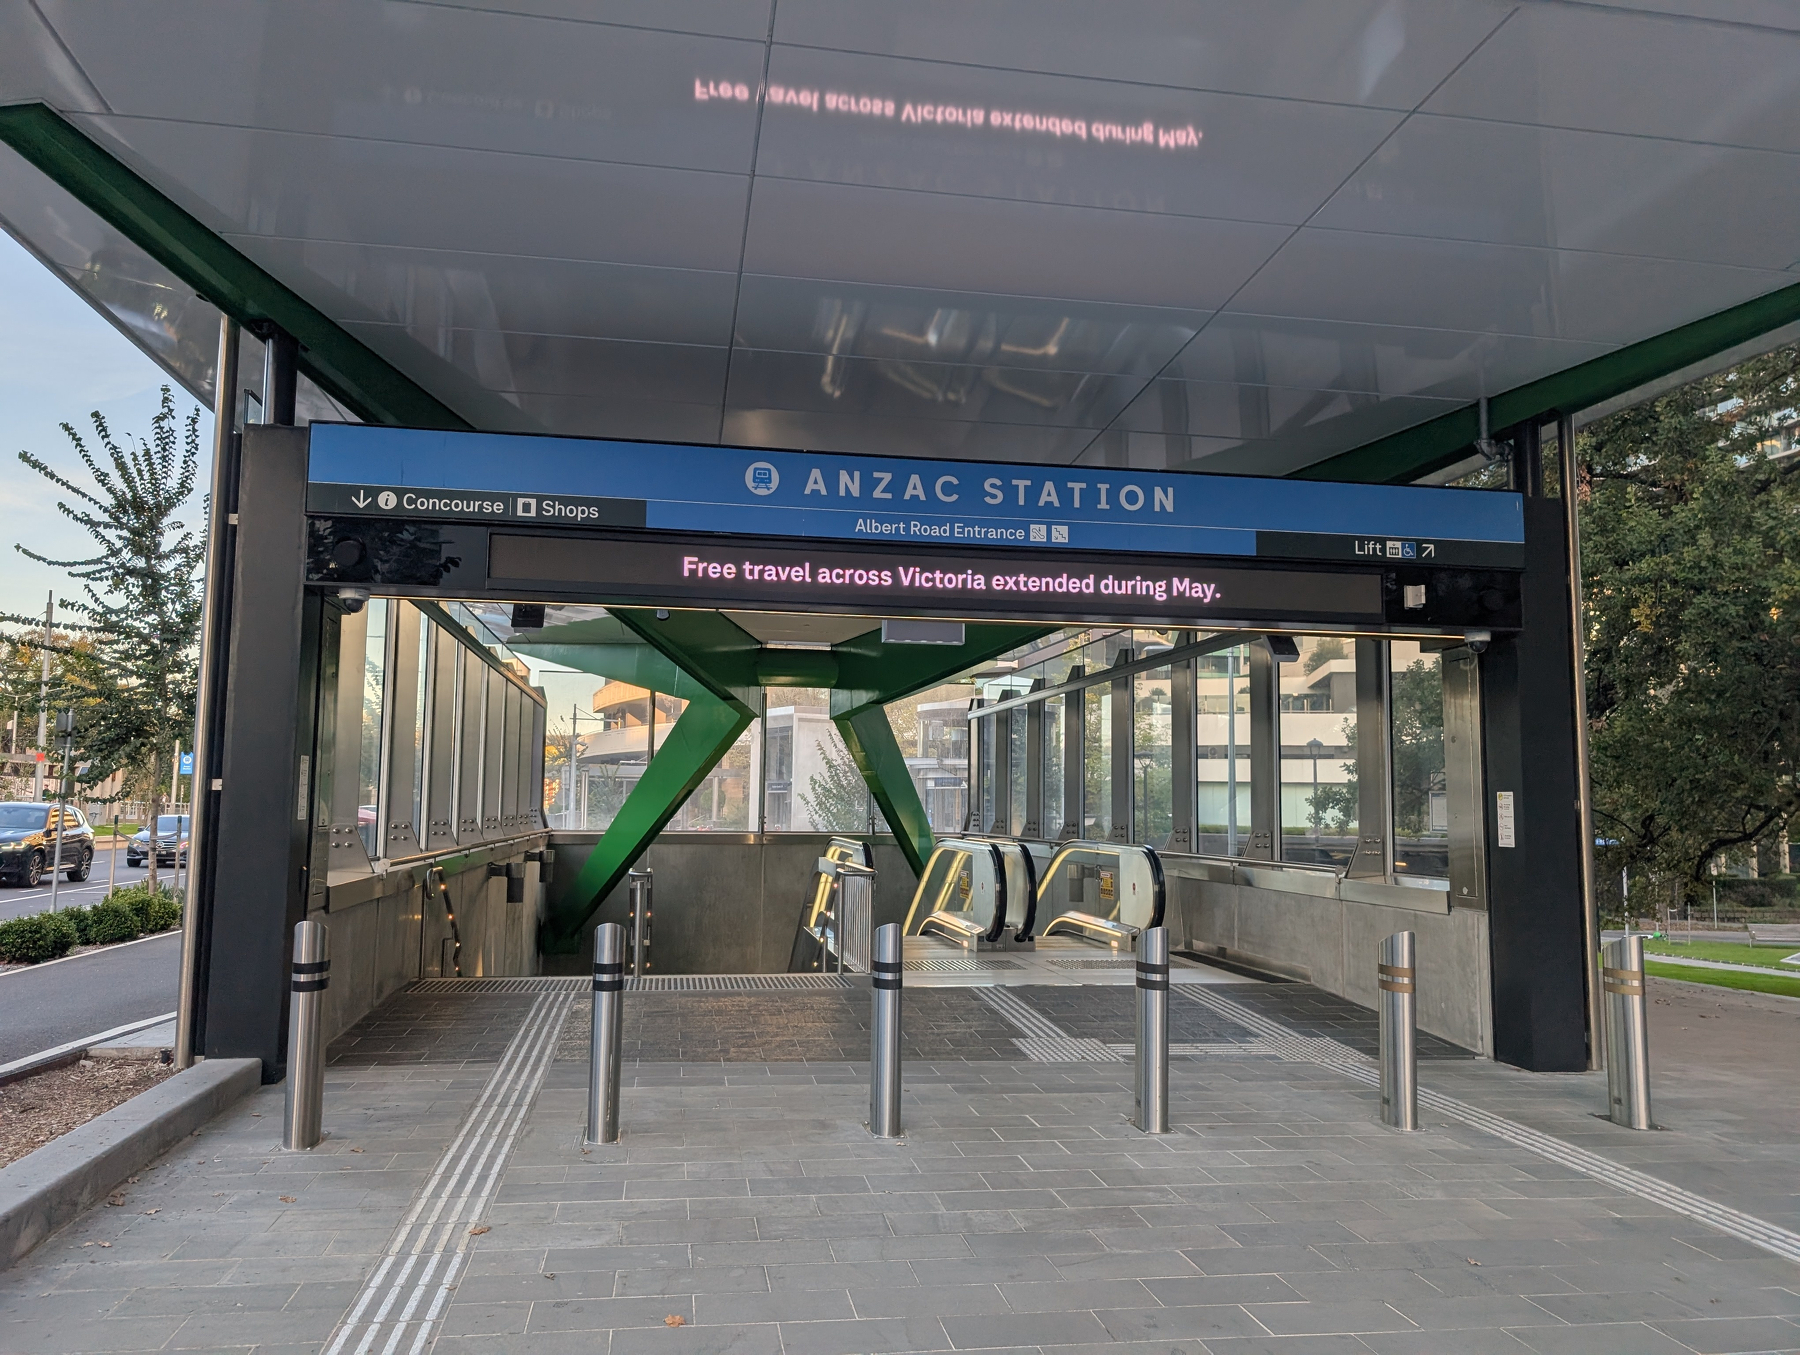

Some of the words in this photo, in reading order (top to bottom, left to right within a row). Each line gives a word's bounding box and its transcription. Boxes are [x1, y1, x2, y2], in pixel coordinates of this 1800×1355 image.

[805, 468, 960, 502] ANZAC
[983, 477, 1175, 513] STATION
[403, 493, 504, 514] Concourse
[541, 501, 599, 522] Shops
[855, 518, 906, 535] Albert
[910, 521, 950, 537] Road
[954, 523, 1026, 540] Entrance
[1355, 540, 1382, 556] Lift
[683, 556, 736, 579] Free
[743, 561, 812, 583] travel
[817, 567, 893, 586] across
[898, 566, 986, 590] Victoria
[991, 573, 1095, 593] extended
[1099, 575, 1167, 601] during
[1172, 577, 1222, 603] May.
